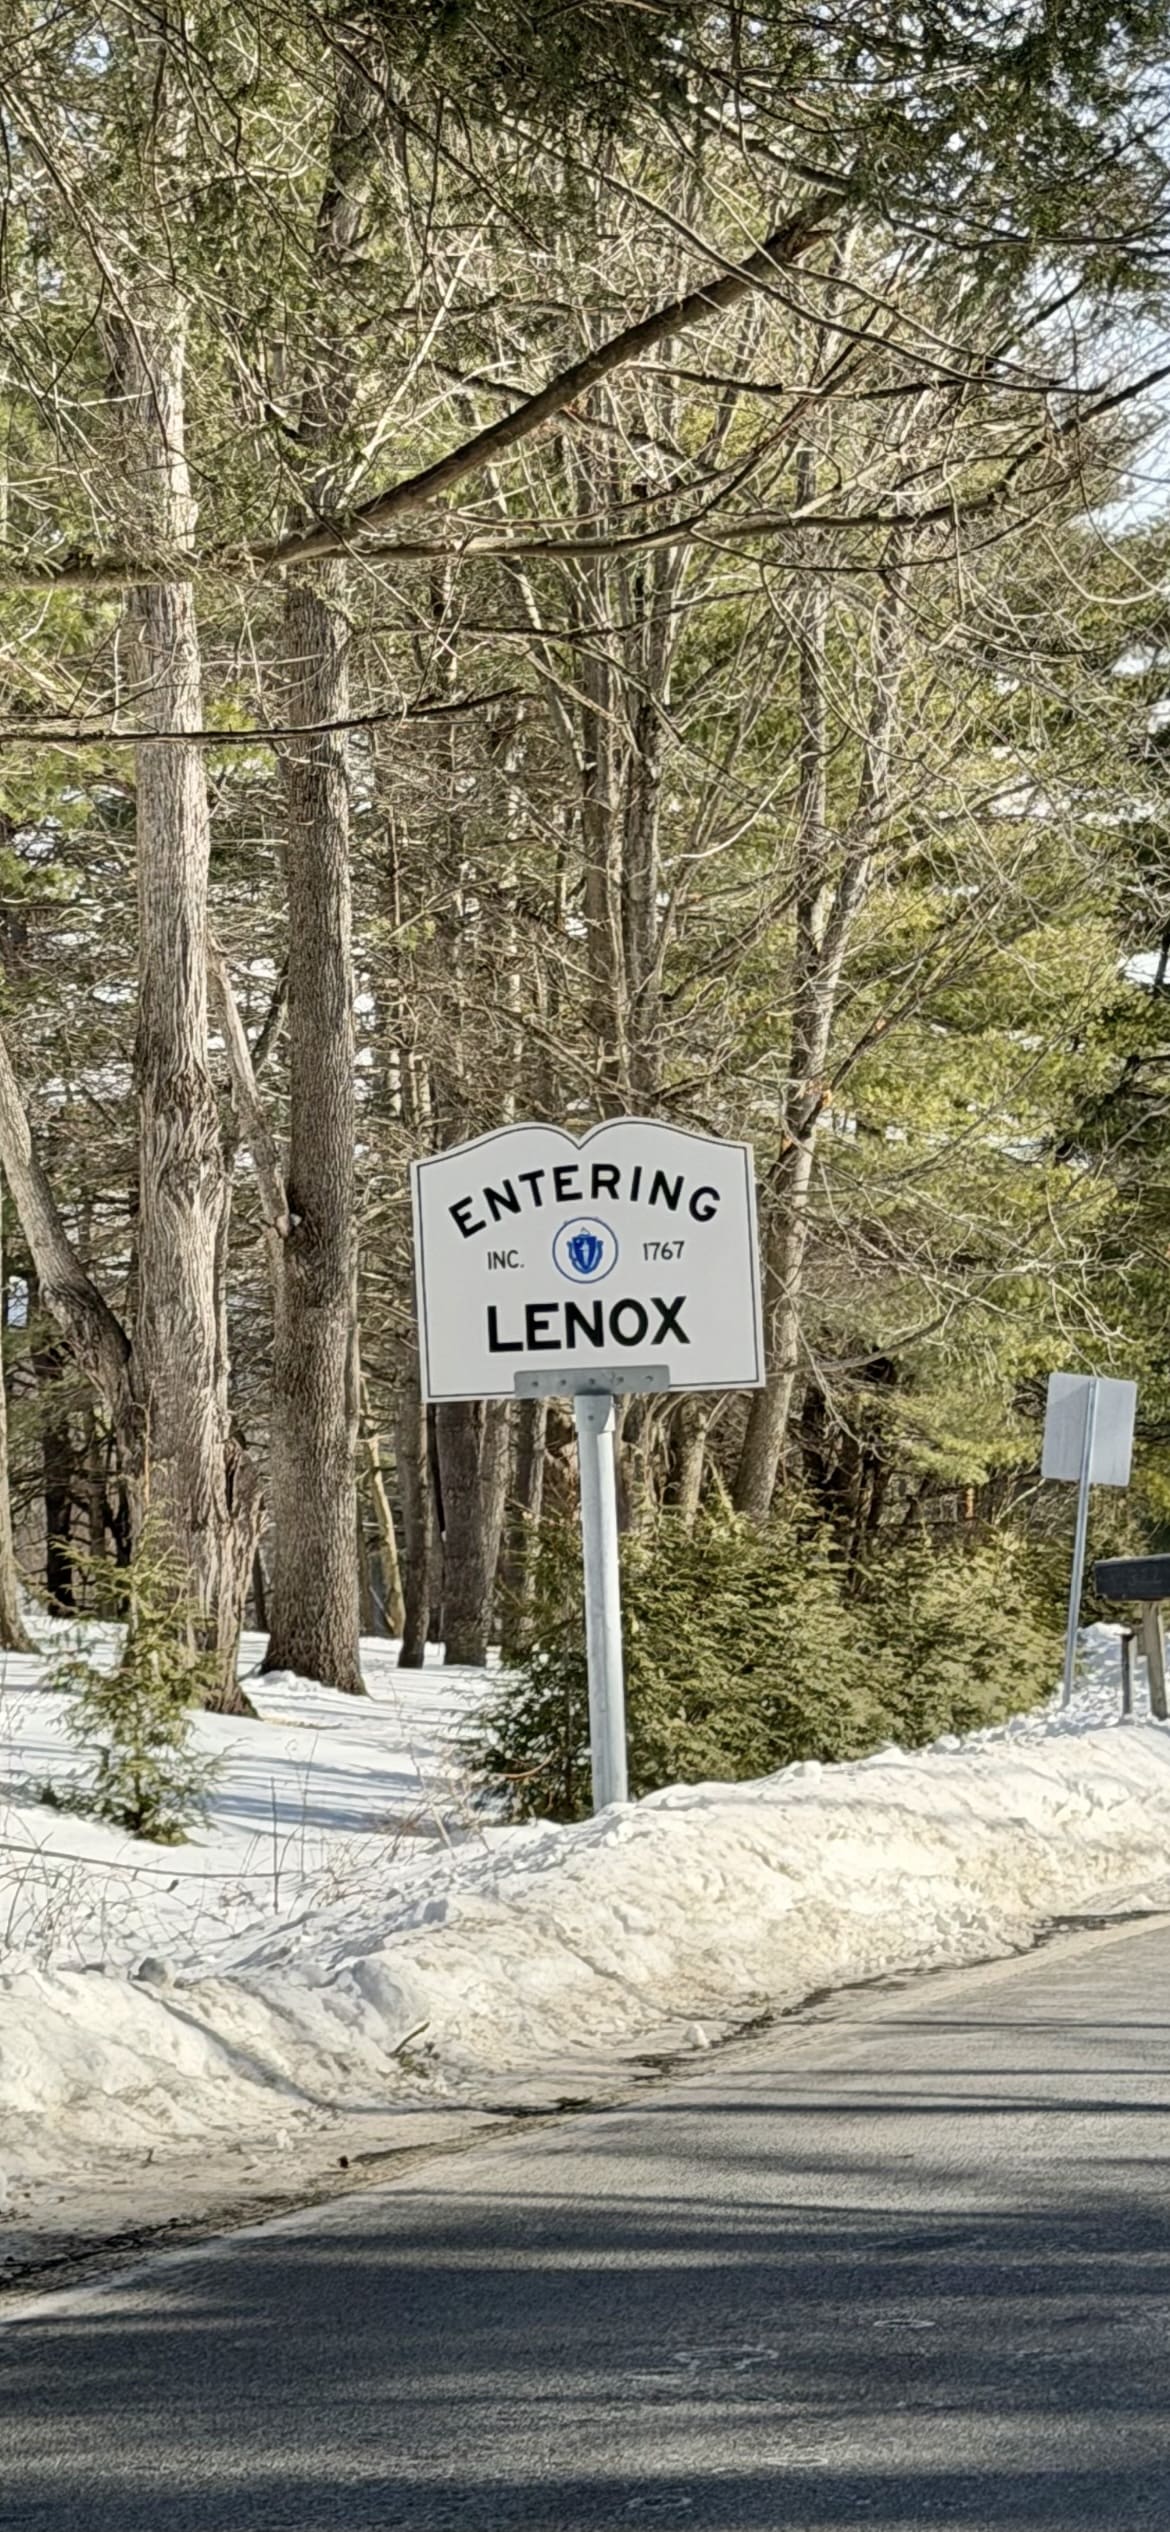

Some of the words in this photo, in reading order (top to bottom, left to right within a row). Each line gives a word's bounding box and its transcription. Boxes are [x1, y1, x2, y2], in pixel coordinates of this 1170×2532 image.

[449, 1163, 721, 1239] ENTERING
[487, 1250, 525, 1270] INC.
[643, 1241, 685, 1261] 1767
[487, 1296, 690, 1353] LENOX
